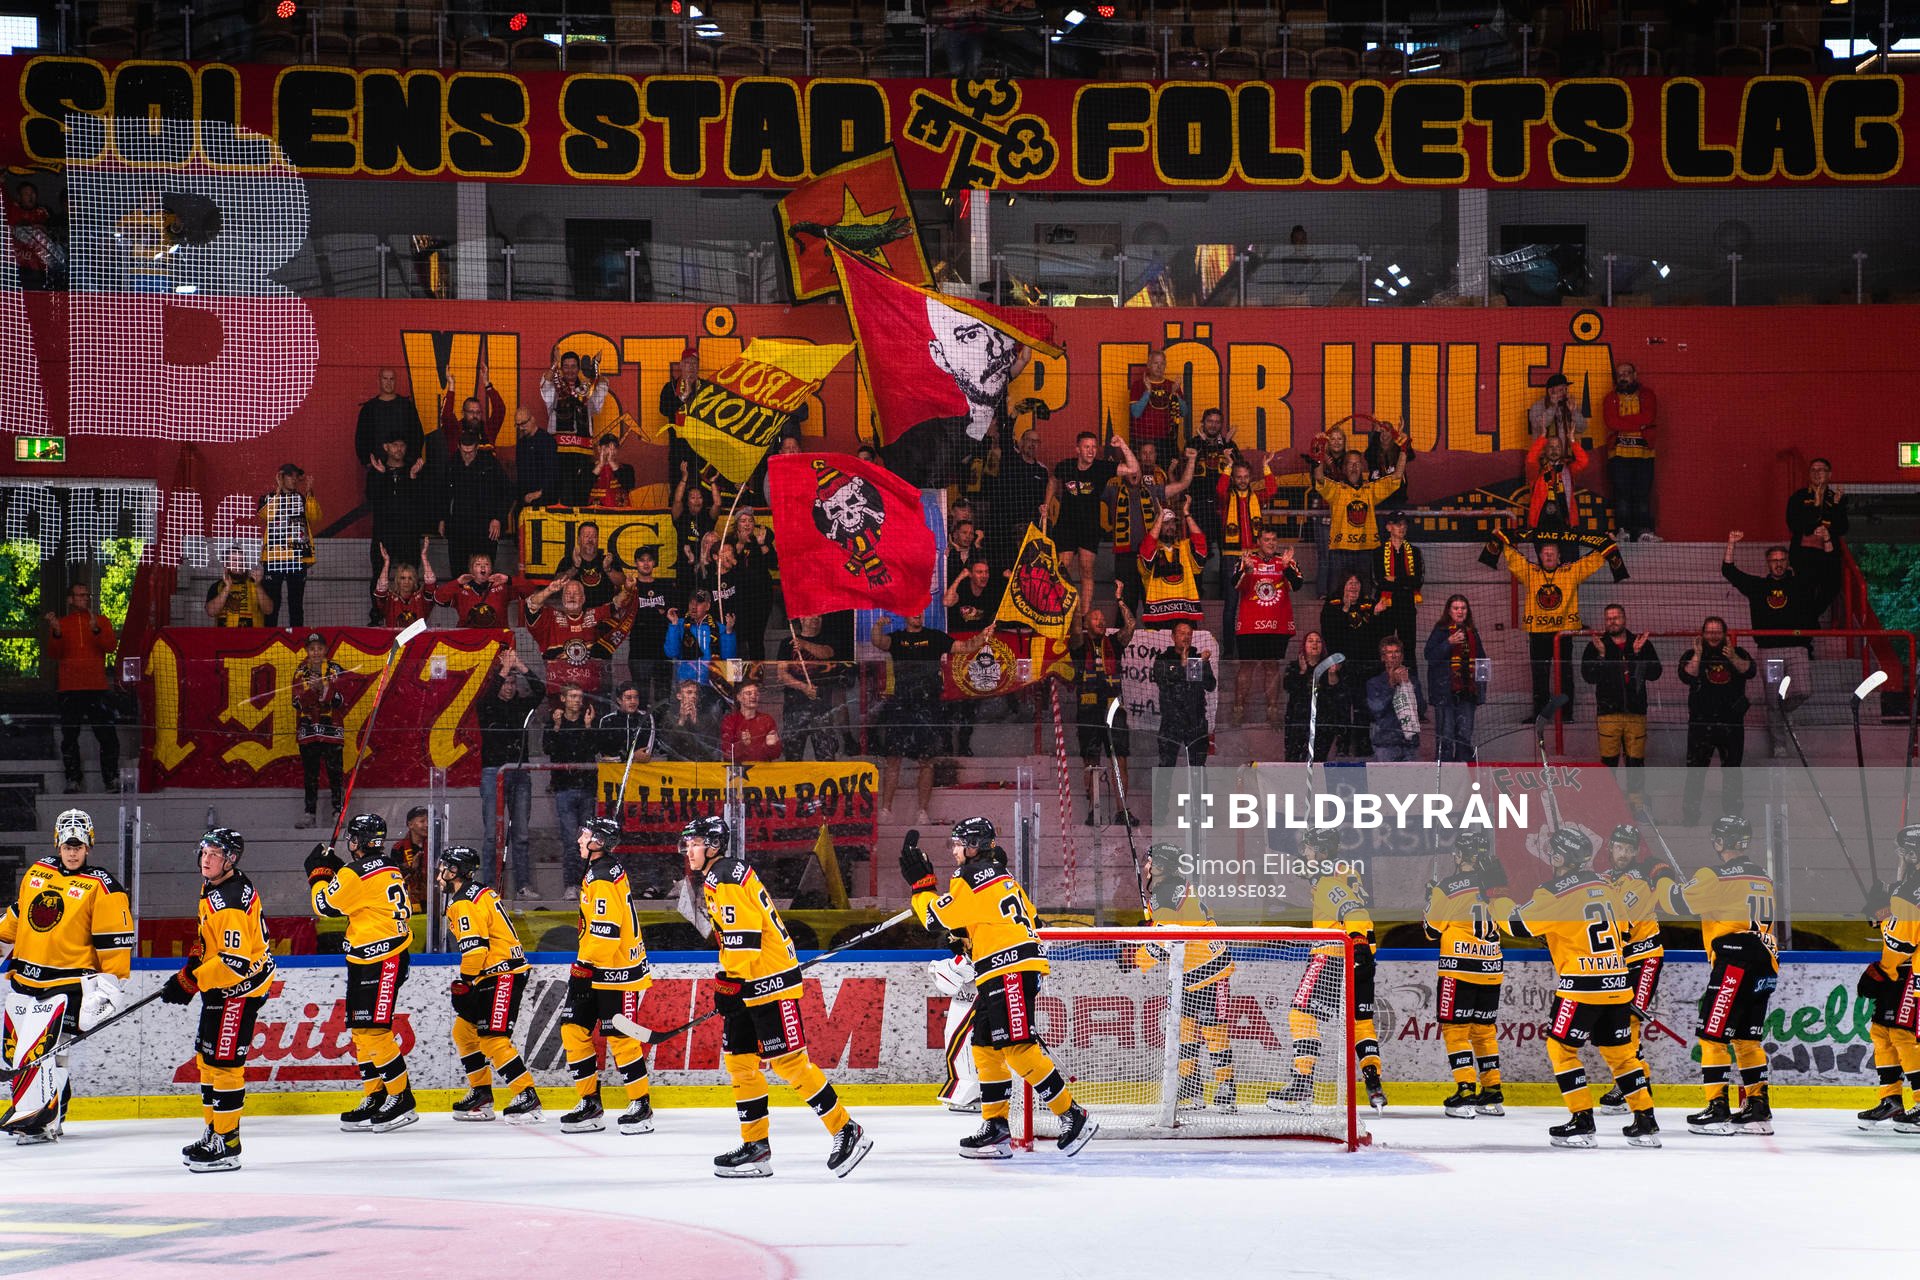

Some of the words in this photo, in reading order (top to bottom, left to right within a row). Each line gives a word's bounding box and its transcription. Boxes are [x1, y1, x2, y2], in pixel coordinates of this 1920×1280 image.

[20, 56, 531, 177] SOLENS
[559, 72, 892, 182] STAD
[1073, 77, 1633, 185] FOLKETS
[1661, 74, 1904, 183] LAG
[1099, 322, 1294, 452] FÖR
[1322, 309, 1617, 452] LULEÅ
[1254, 620, 1278, 630] SSAB
[1536, 615, 1563, 627] SSAB
[146, 635, 500, 776] 1977
[795, 771, 875, 819] BOYS
[362, 858, 384, 872] SSAB
[973, 867, 996, 884] SSAB
[1554, 875, 1579, 892] SSAB
[1448, 879, 1471, 892] SSAB
[1328, 886, 1347, 905] 26
[224, 930, 241, 949] 96
[363, 942, 390, 957] SSAB
[991, 950, 1019, 968] SSAB
[603, 970, 630, 981] SSAB
[1601, 976, 1627, 990] SSAB
[221, 980, 253, 999] SSAB
[754, 976, 784, 996] SSAB
[1634, 965, 1656, 1013] Näiden
[375, 971, 396, 1022] Näiden
[491, 980, 511, 1030] Näiden
[32, 1004, 54, 1014] SSAB
[1005, 981, 1025, 1039] Näiden
[1706, 984, 1735, 1034] Näiden
[217, 1000, 242, 1057] Näiden
